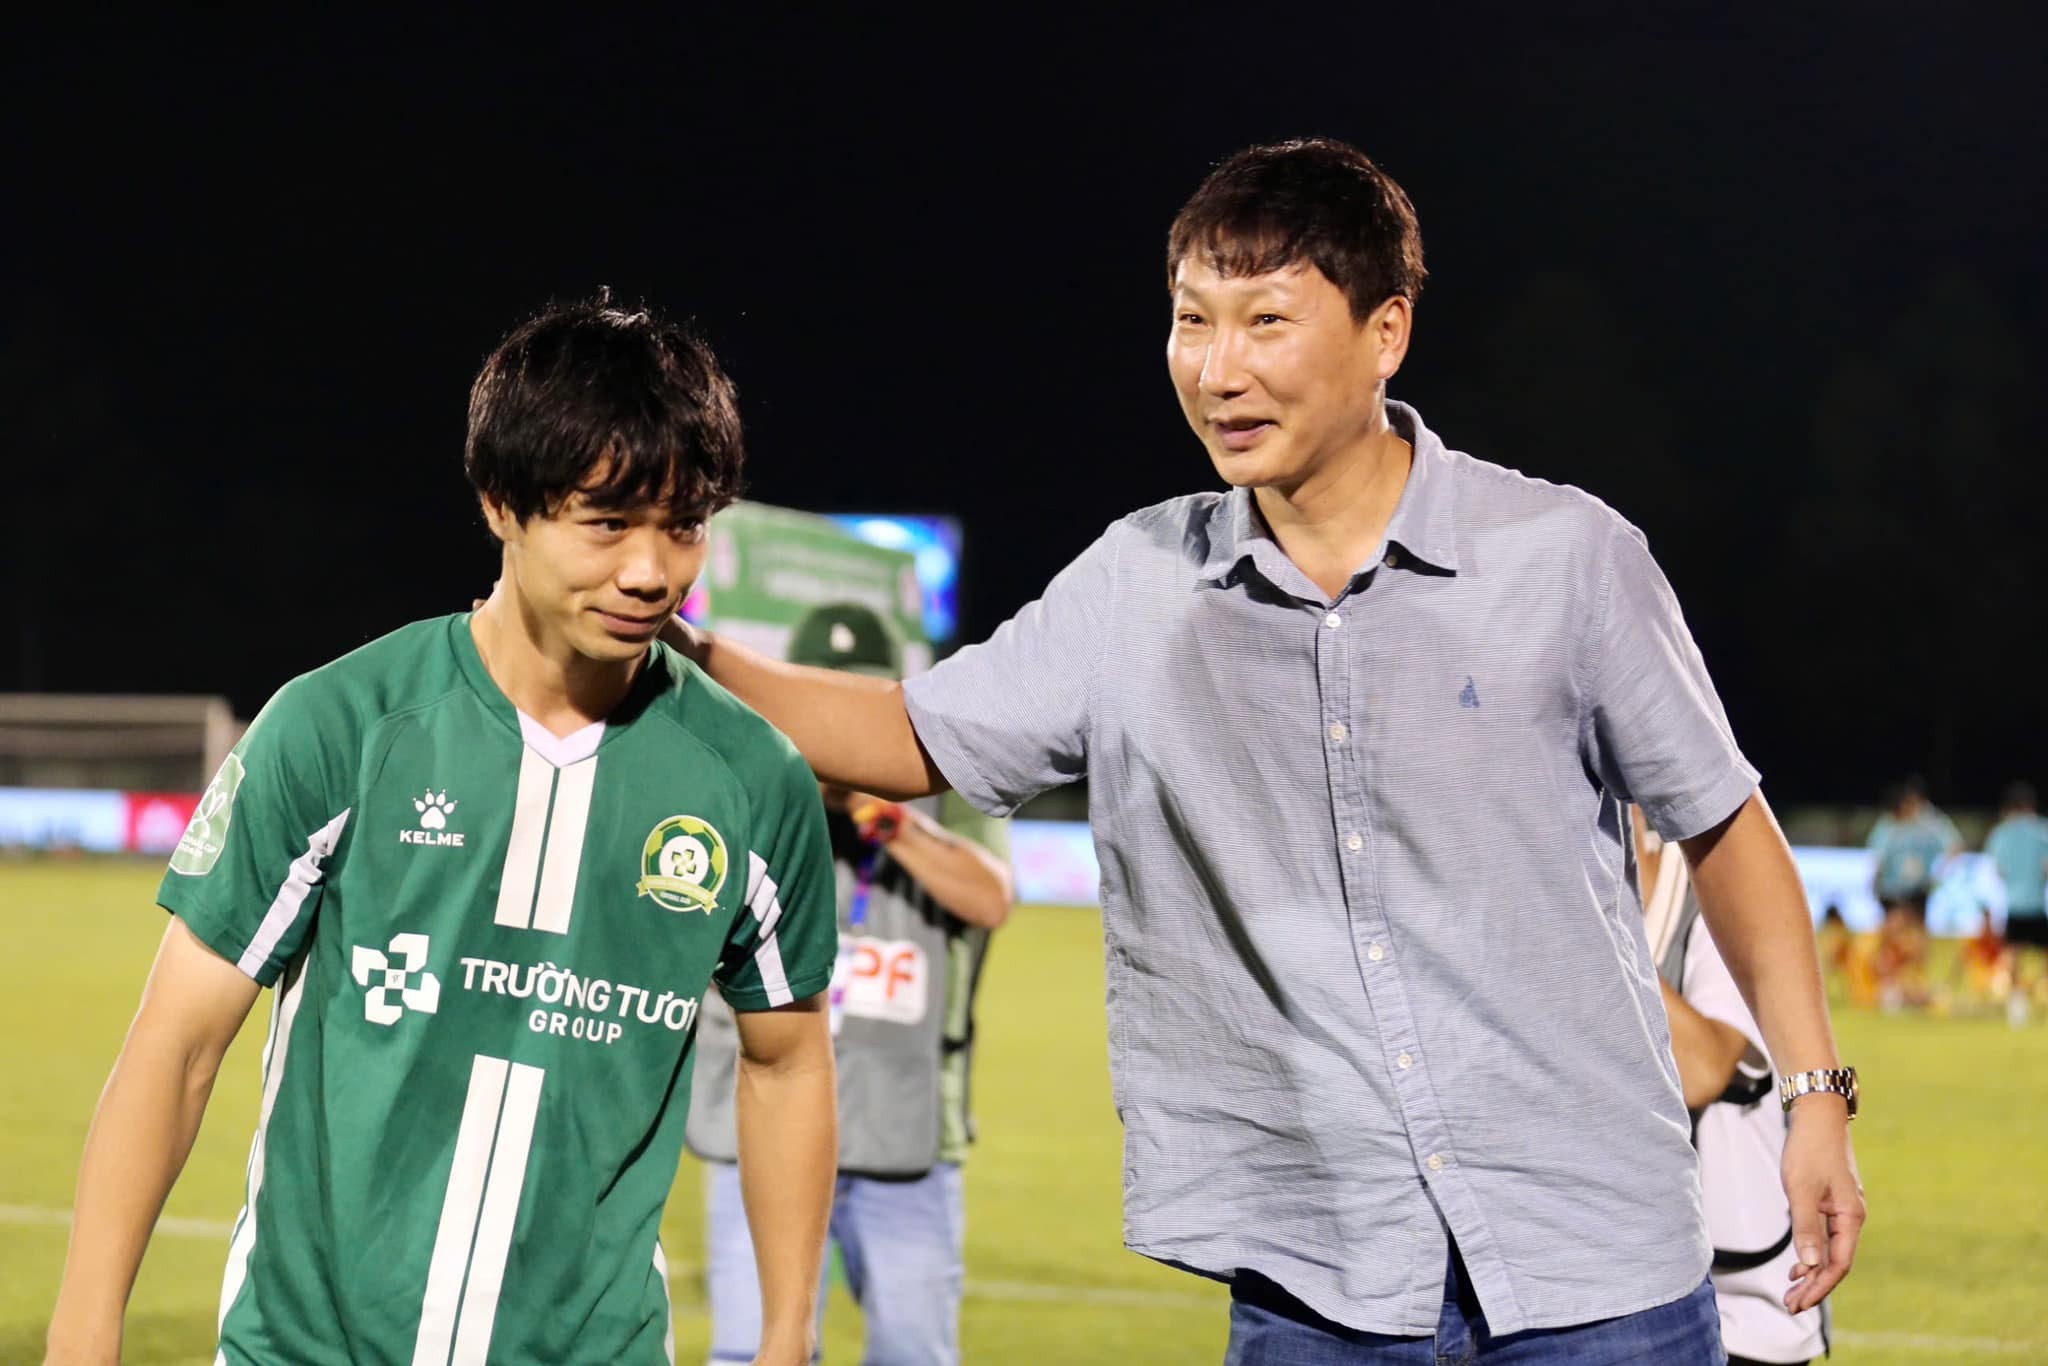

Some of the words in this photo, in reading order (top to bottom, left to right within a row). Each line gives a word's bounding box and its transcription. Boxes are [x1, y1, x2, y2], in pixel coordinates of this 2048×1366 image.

[400, 829, 465, 847] KELME
[460, 957, 611, 1013] TRƯỜNG
[528, 1009, 623, 1044] GROUP
